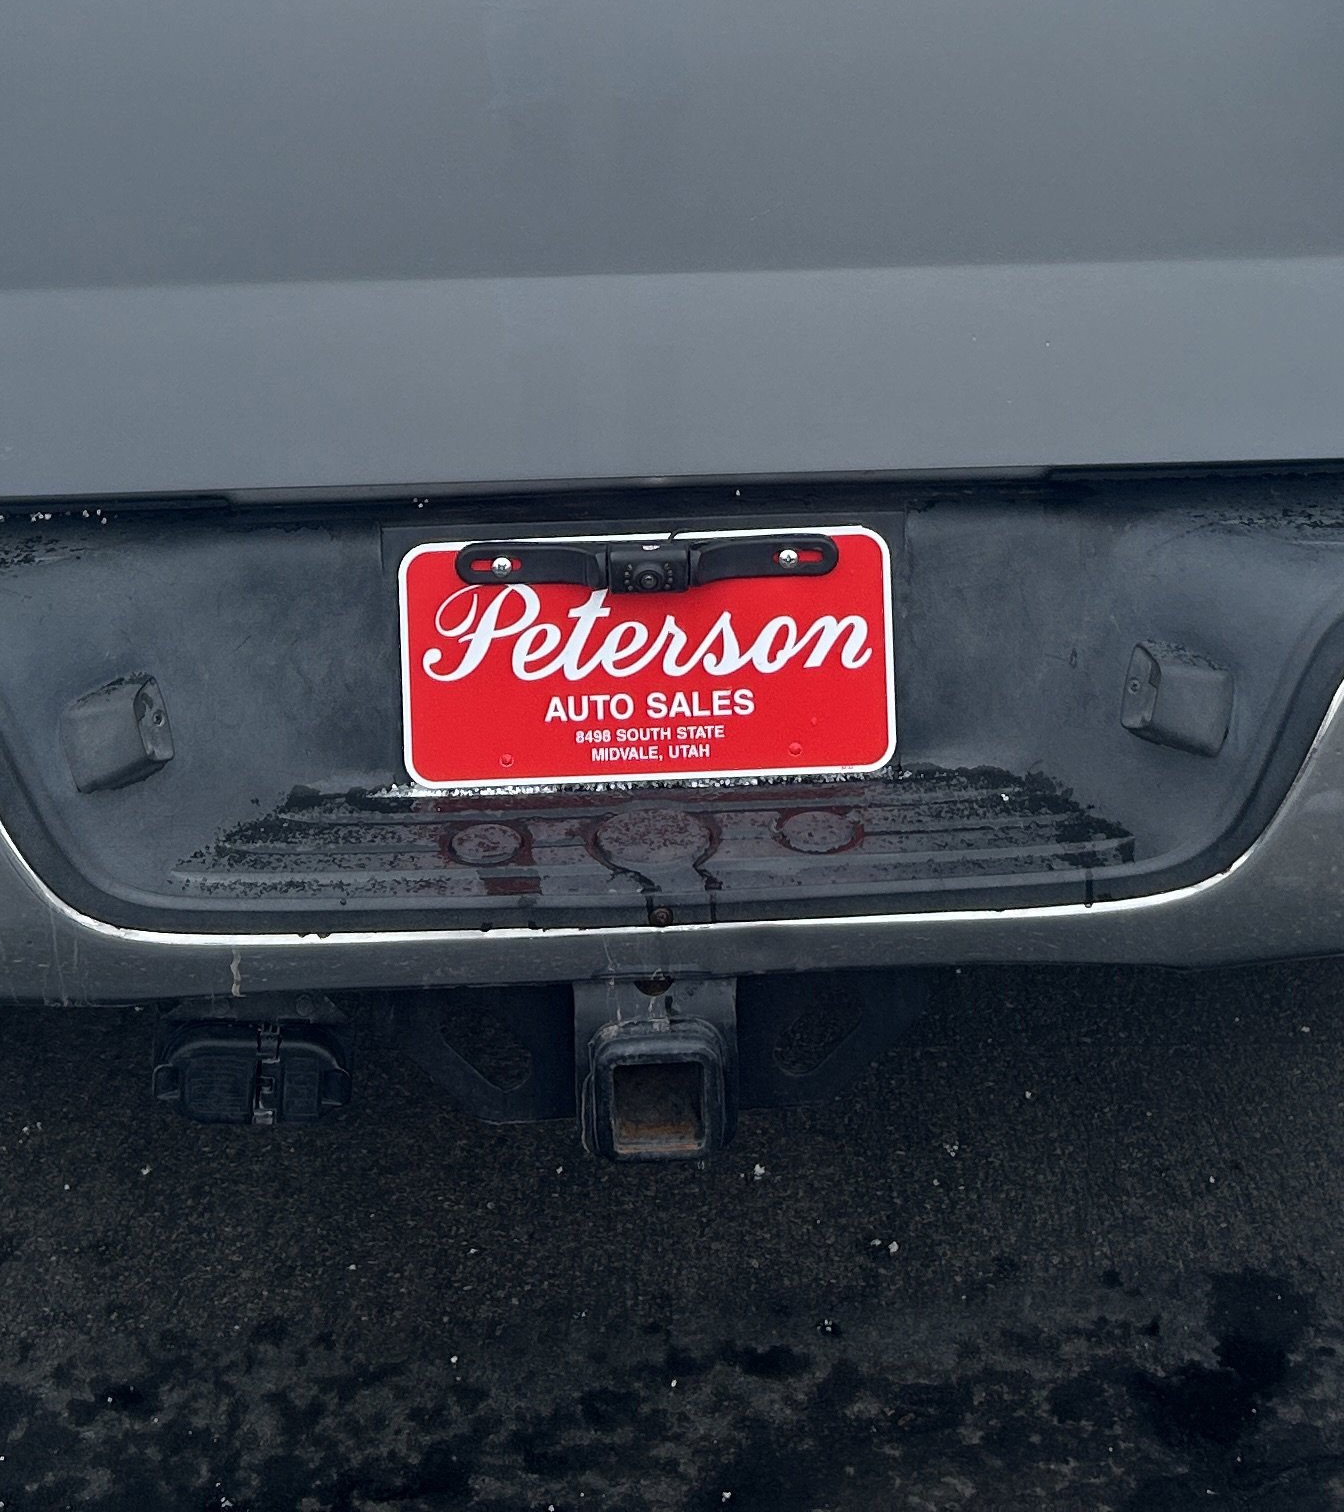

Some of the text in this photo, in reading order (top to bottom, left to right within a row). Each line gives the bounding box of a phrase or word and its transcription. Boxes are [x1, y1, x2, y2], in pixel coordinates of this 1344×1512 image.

[422, 583, 873, 682] Peterson
[544, 688, 755, 723] AUTO SALES
[575, 725, 725, 744] 8498 SOUTH STATE
[591, 744, 710, 762] MIDVALE, UTAH
